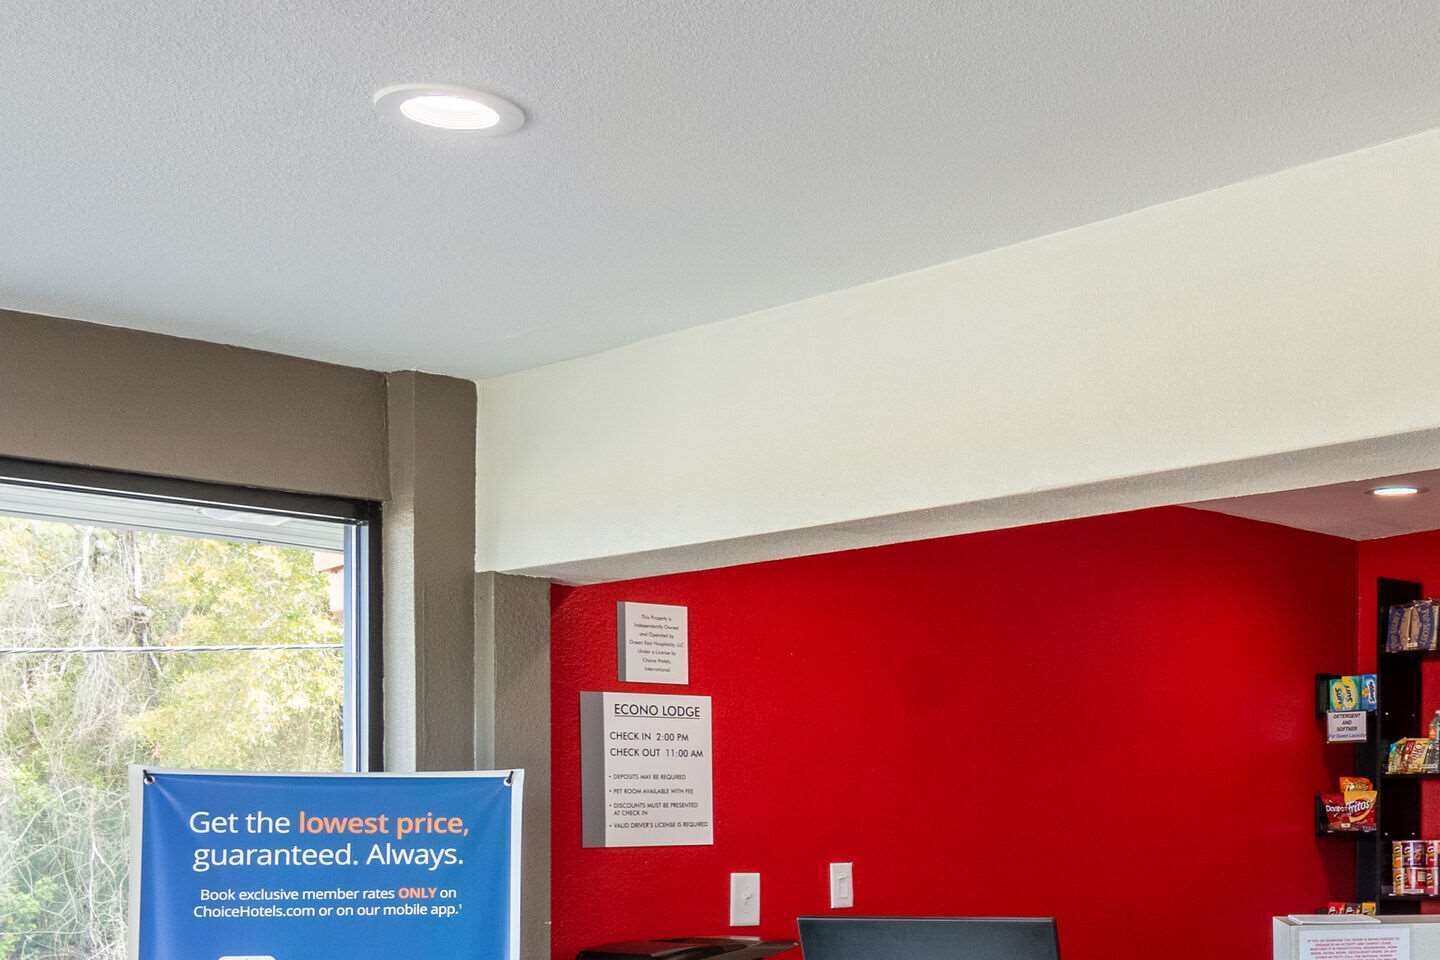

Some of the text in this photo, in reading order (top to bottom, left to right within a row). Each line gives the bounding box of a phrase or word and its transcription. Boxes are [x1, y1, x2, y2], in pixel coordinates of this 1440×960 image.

[614, 703, 701, 717] ECONO LODGE
[609, 731, 689, 742] CHECK IN 2:00 PM
[609, 748, 704, 758] CHECK OUT 11:00 AM
[189, 811, 469, 839] Get the lowest price,
[192, 843, 463, 872] guaranteed. Always.
[201, 887, 456, 900] Book exclusive member rates ONLY on
[193, 905, 317, 917] ChoiceHotels.com
[318, 907, 334, 916] or
[336, 907, 353, 916] on
[357, 907, 381, 916] our
[383, 904, 428, 915] mobile
